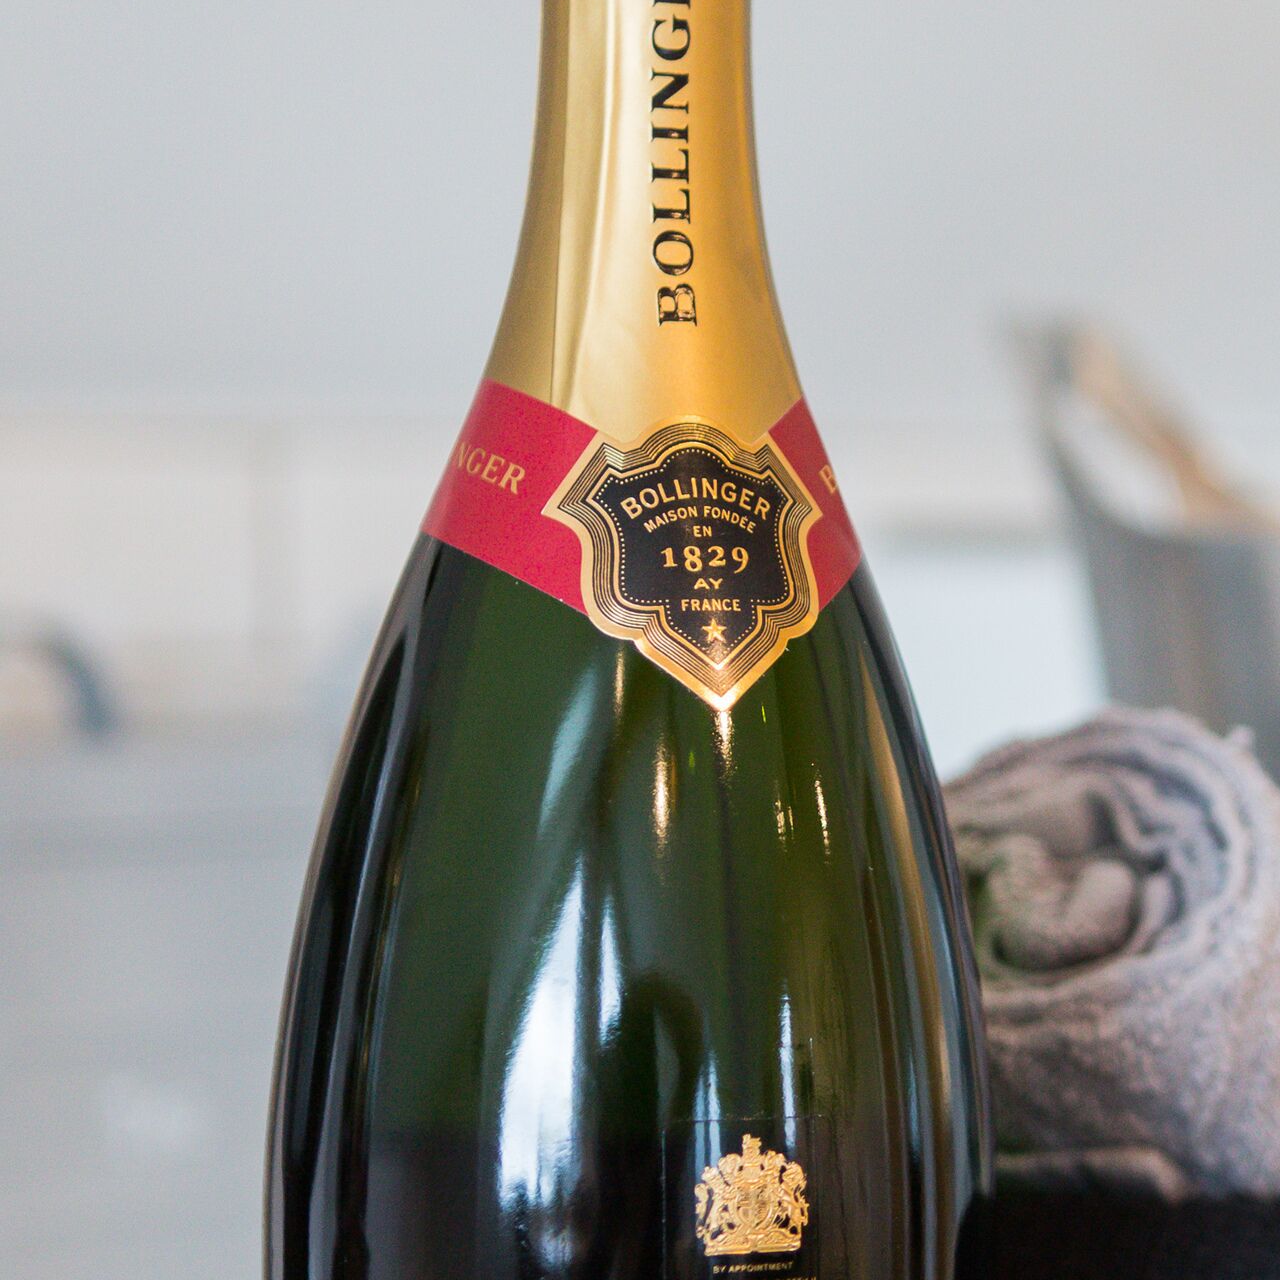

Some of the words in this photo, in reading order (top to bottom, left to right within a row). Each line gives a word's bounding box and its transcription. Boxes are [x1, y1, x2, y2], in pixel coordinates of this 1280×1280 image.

[620, 477, 771, 520] BOLLINGER
[643, 505, 698, 533] MAISON
[703, 505, 757, 534] FONDÉE
[692, 525, 713, 538] EN
[660, 545, 749, 574] 1829
[693, 578, 724, 590] AY
[680, 598, 742, 612] FRANCE
[713, 1264, 726, 1274] BY
[728, 1262, 793, 1273] APPOINTMENT
